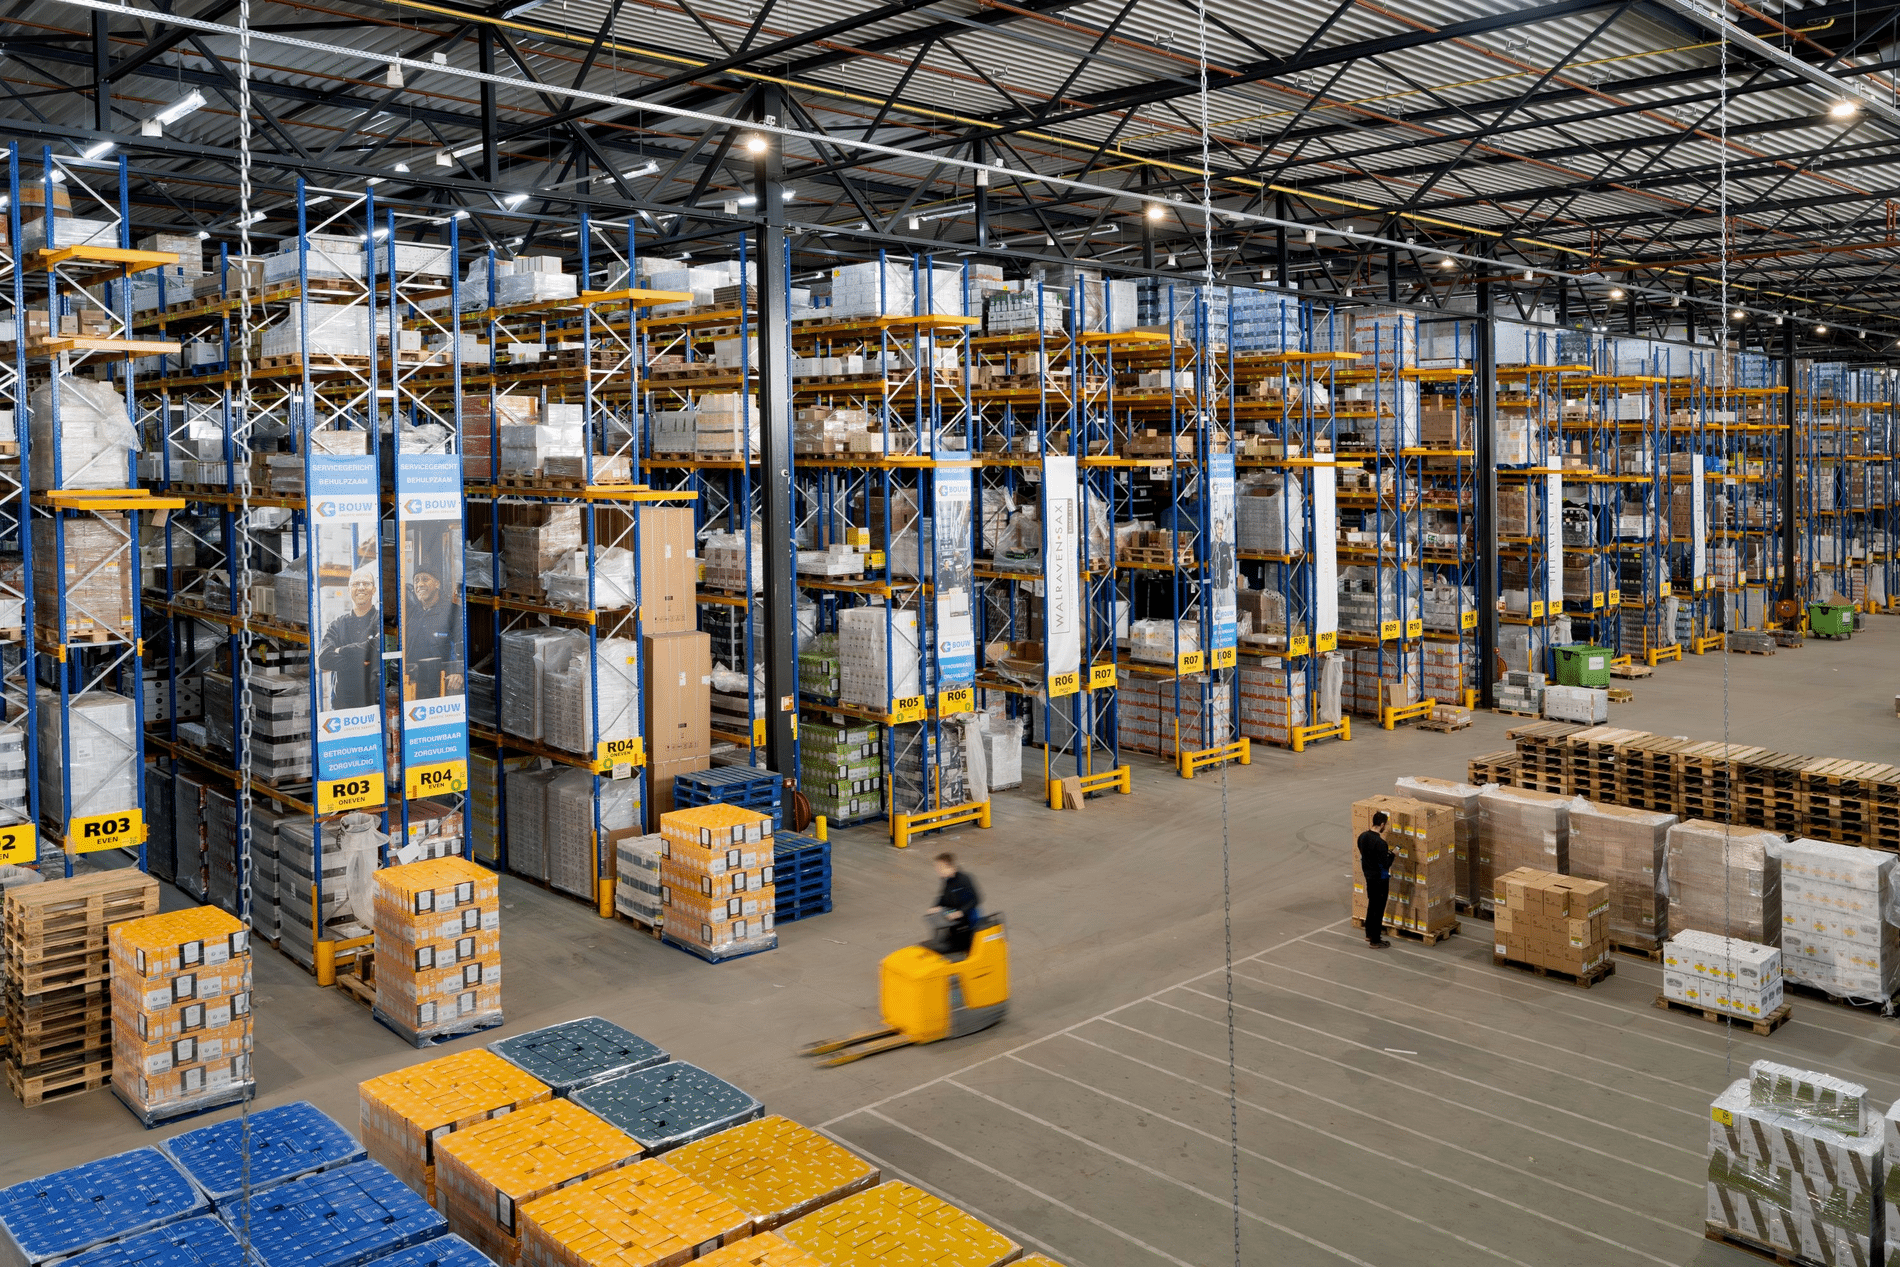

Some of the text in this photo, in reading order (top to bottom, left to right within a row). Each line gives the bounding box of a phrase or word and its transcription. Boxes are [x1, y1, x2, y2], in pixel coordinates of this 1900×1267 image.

[312, 464, 374, 472] SERVICEGERICHT
[400, 463, 458, 471] SERVICEGERICHT
[406, 476, 453, 484] BEHULPZAAM
[338, 502, 373, 512] BOUW
[425, 500, 457, 509] BOUW
[1385, 623, 1397, 632] R09
[1321, 632, 1333, 641] R09
[952, 640, 971, 649] BOUW
[1183, 655, 1198, 666] R07
[1095, 668, 1112, 680] R07
[1055, 674, 1073, 687] R06
[947, 690, 967, 702] R06
[429, 702, 461, 716] BOUW
[899, 697, 919, 709] R05
[343, 713, 376, 727] BOUW
[409, 731, 462, 746] BETROUWBAAR
[323, 743, 377, 759] BETROUWBAAR
[413, 745, 458, 758] ZORGVULDIG
[607, 738, 634, 753] R04
[610, 750, 631, 758] ONEVEN
[328, 758, 374, 772] ZORGVULDIG
[420, 768, 453, 786] R04
[332, 779, 370, 799] R03
[428, 782, 445, 790] EVEN
[338, 796, 366, 806] ONEVEN
[84, 817, 131, 838] R03
[97, 836, 119, 845] EVEN
